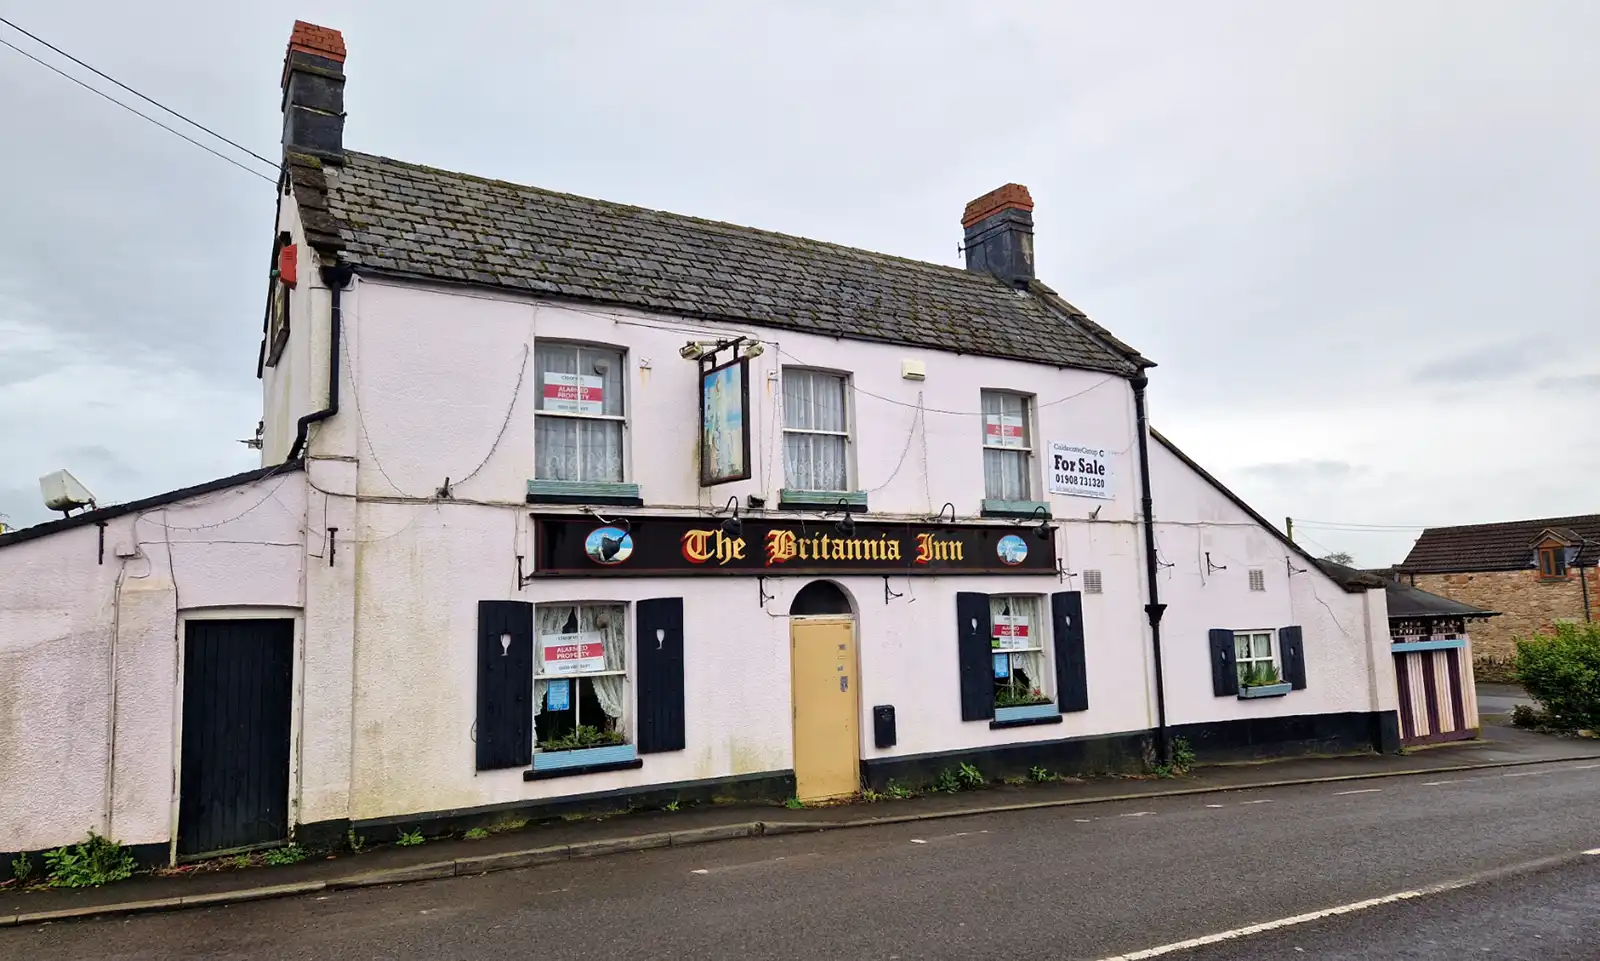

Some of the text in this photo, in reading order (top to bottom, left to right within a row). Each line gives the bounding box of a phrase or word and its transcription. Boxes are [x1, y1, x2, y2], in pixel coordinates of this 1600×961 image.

[1054, 454, 1105, 476] For Sale
[1055, 473, 1105, 488] 01908 731320
[680, 529, 964, 566] The Britannia Inn
[556, 651, 590, 660] PROPETY
